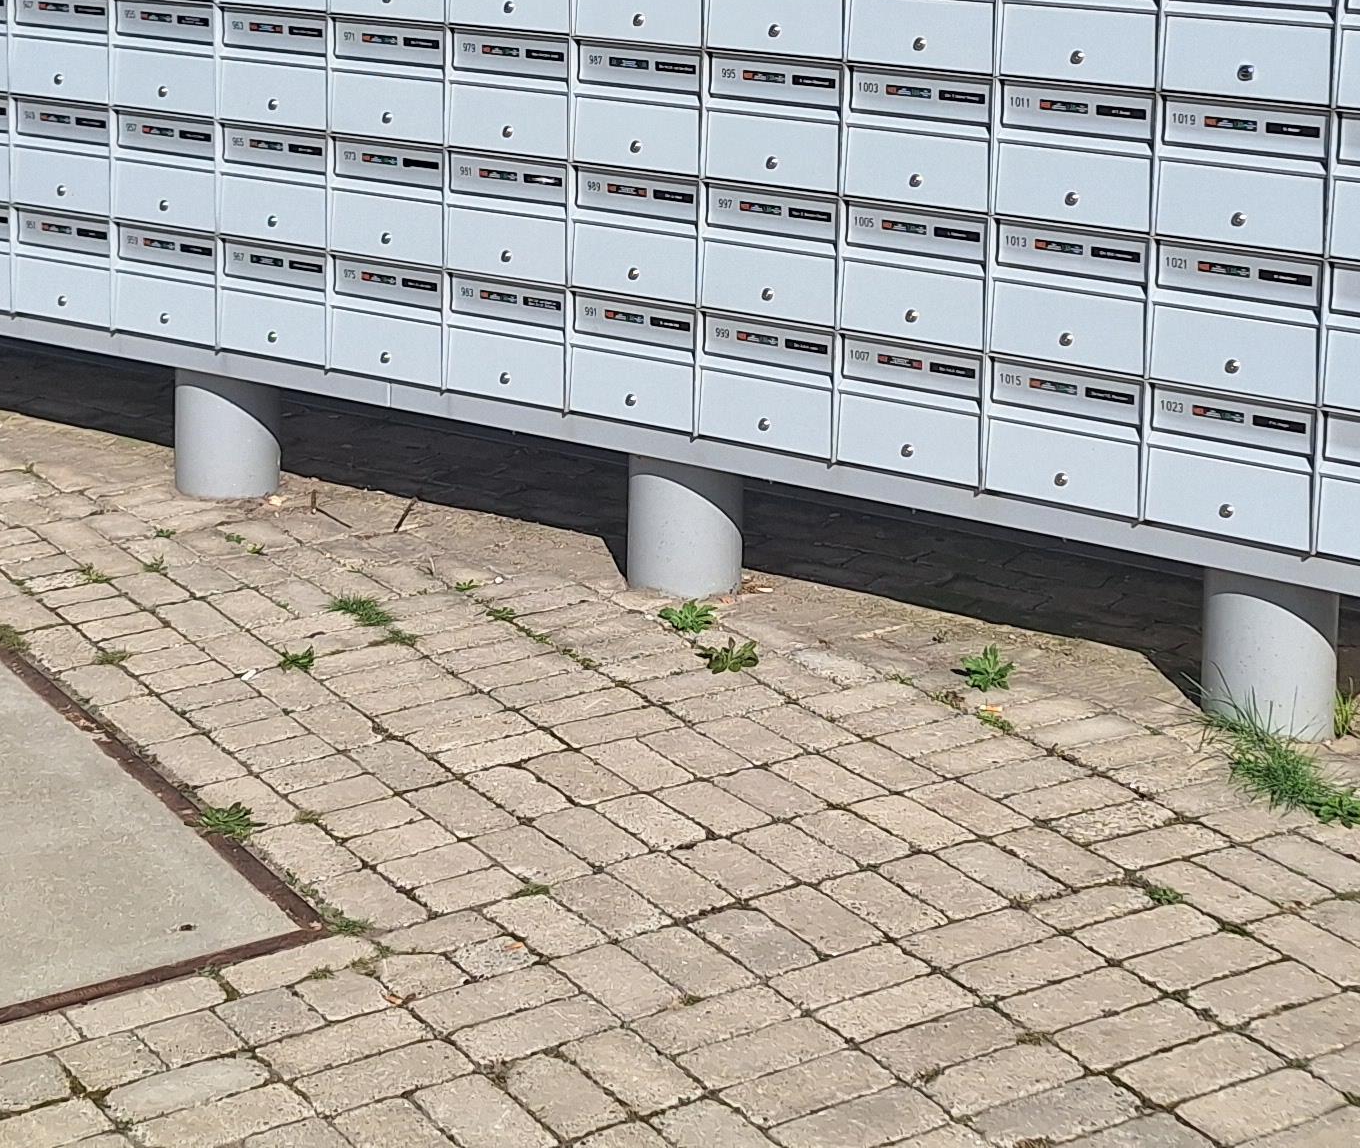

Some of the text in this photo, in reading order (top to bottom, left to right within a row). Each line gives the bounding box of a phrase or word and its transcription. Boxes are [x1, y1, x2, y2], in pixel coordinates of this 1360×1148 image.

[589, 55, 603, 65] 987
[721, 68, 736, 79] 995
[858, 82, 879, 93] 1003
[1010, 97, 1030, 108] 1011
[1172, 113, 1196, 126] 1019
[587, 182, 601, 192] 989
[718, 199, 733, 210] 997
[854, 217, 875, 228] 1005
[1005, 235, 1027, 248] 1013
[1166, 257, 1188, 269] 1021
[584, 306, 597, 317] 991
[850, 350, 870, 361] 1007
[999, 373, 1021, 386] 1015
[1160, 400, 1184, 413] 1023
